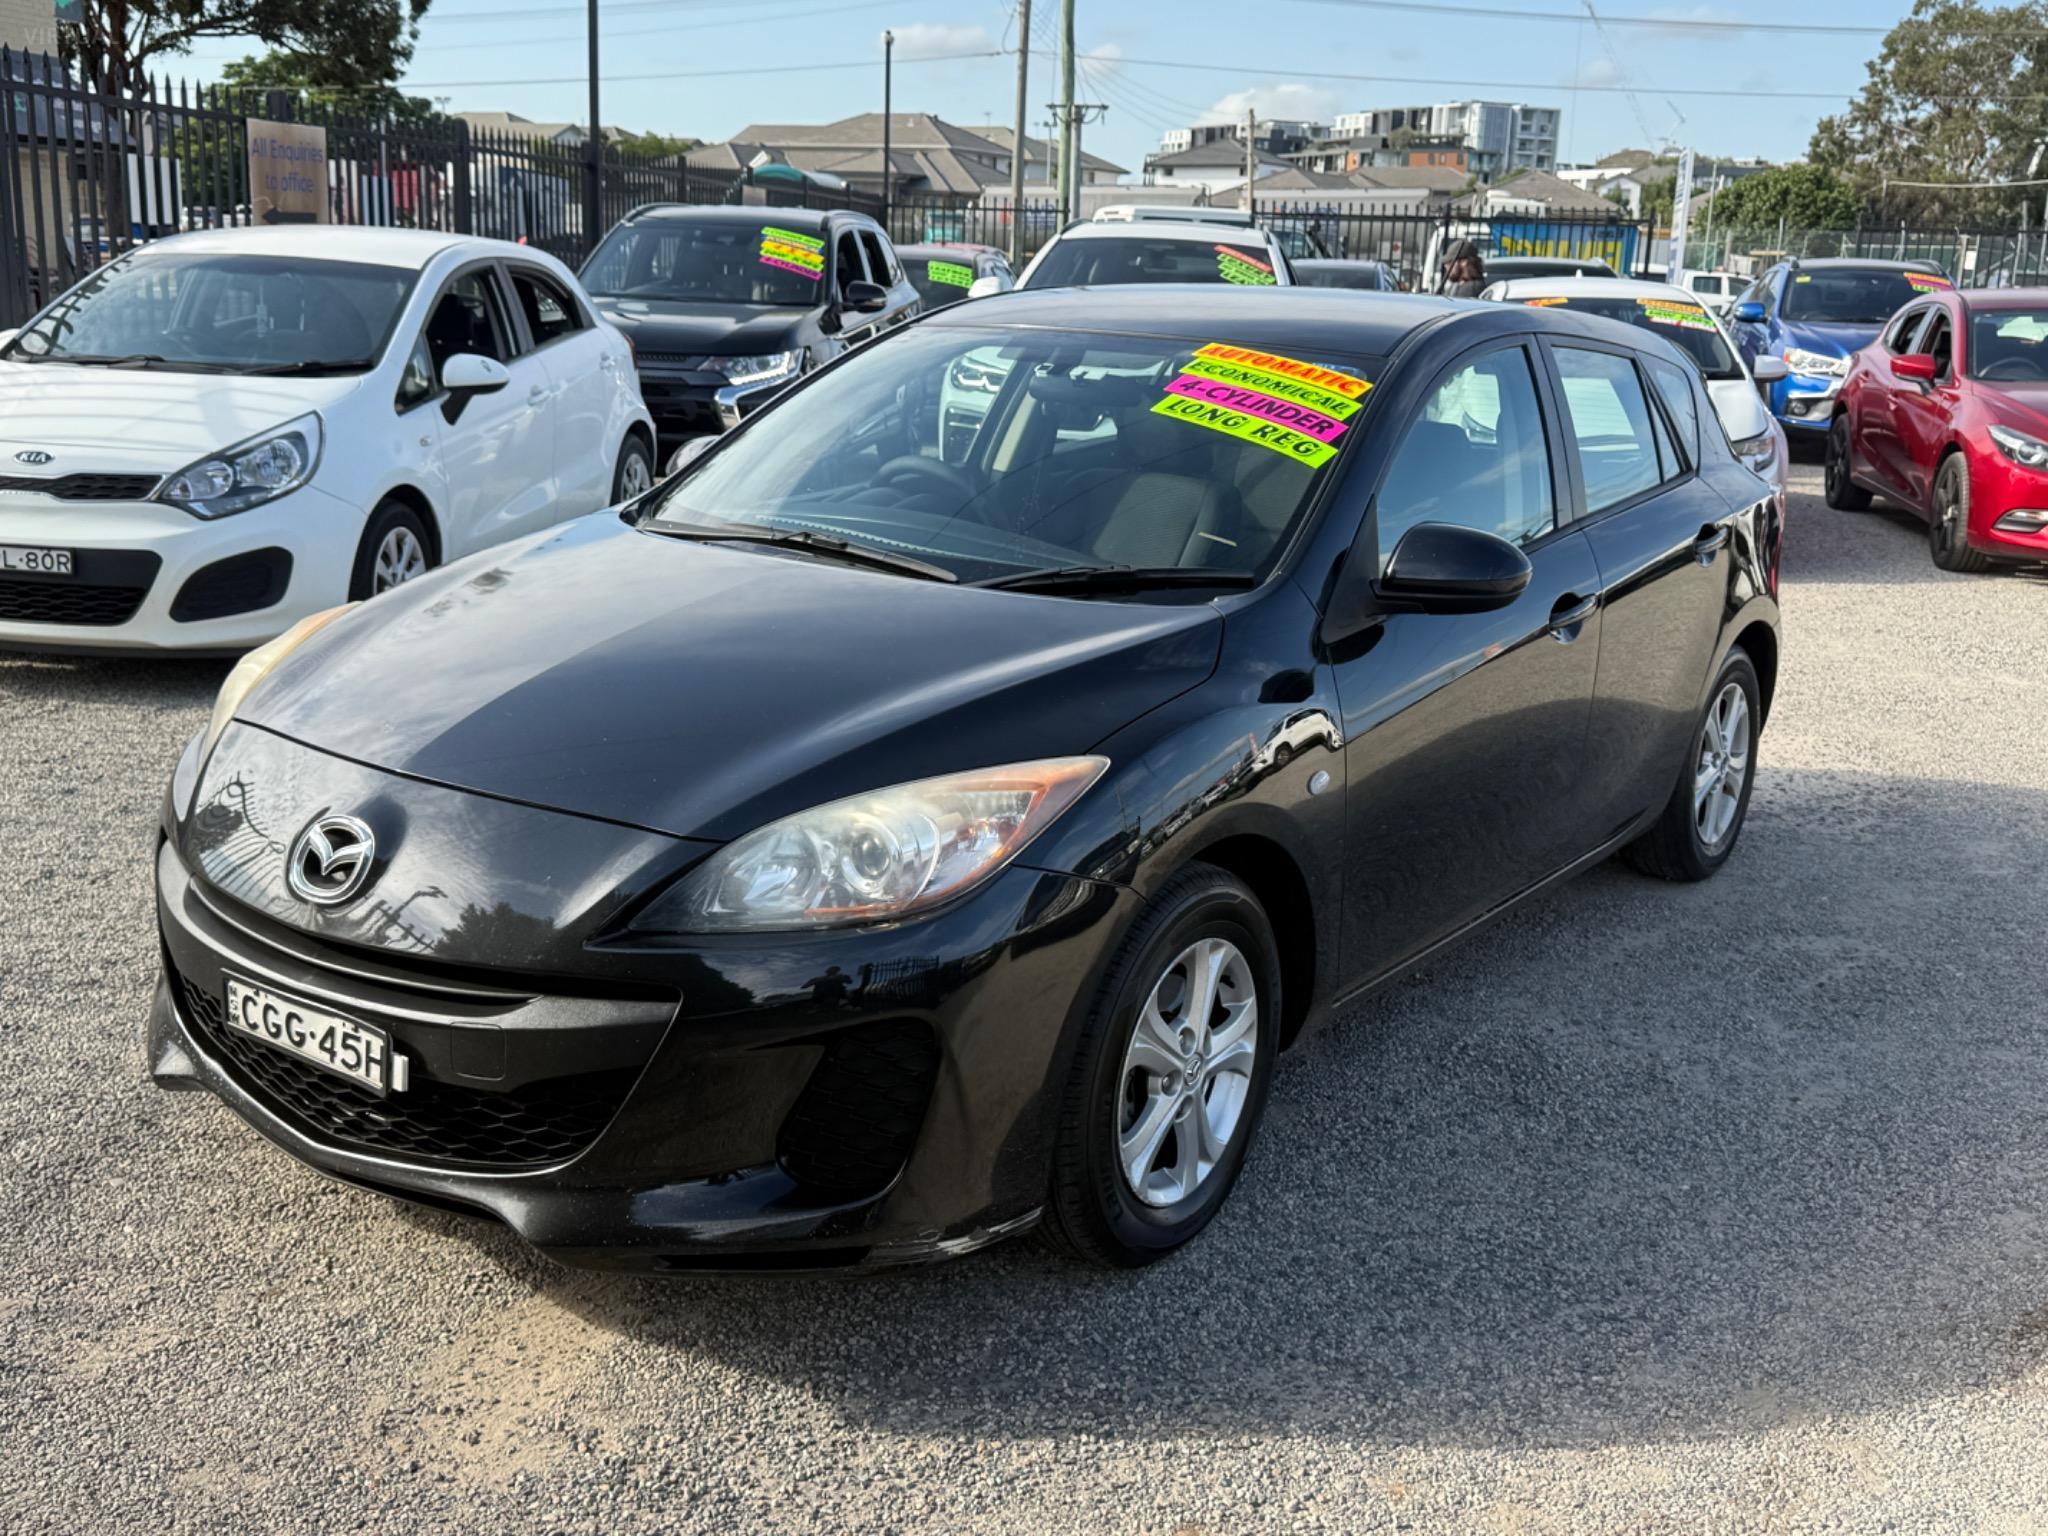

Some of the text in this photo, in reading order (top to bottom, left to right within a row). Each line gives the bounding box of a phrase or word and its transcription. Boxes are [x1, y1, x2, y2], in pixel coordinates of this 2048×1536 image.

[251, 138, 323, 165] All Enquiries
[265, 171, 314, 193] to office
[1189, 361, 1351, 415] ECONOMICAL
[1198, 346, 1366, 393] AUTOMATIC
[1165, 399, 1321, 455] LONG REG
[1179, 381, 1335, 435] 4-CYLINDER
[20, 452, 46, 462] KIA
